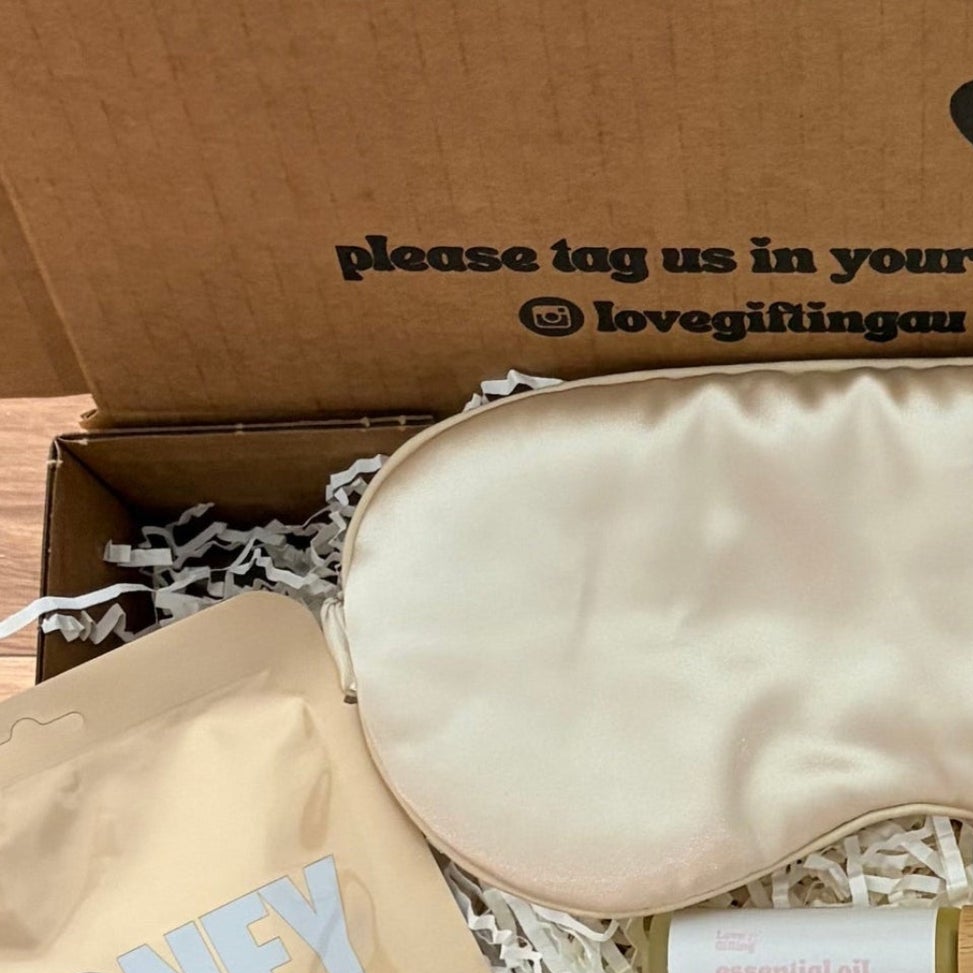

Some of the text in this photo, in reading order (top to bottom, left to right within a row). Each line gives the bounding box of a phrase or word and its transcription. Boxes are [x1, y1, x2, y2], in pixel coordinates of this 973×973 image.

[335, 235, 540, 282] please
[550, 238, 649, 284] tag
[661, 247, 737, 274] us
[750, 236, 817, 274] in
[597, 300, 966, 342] lovegiftingau
